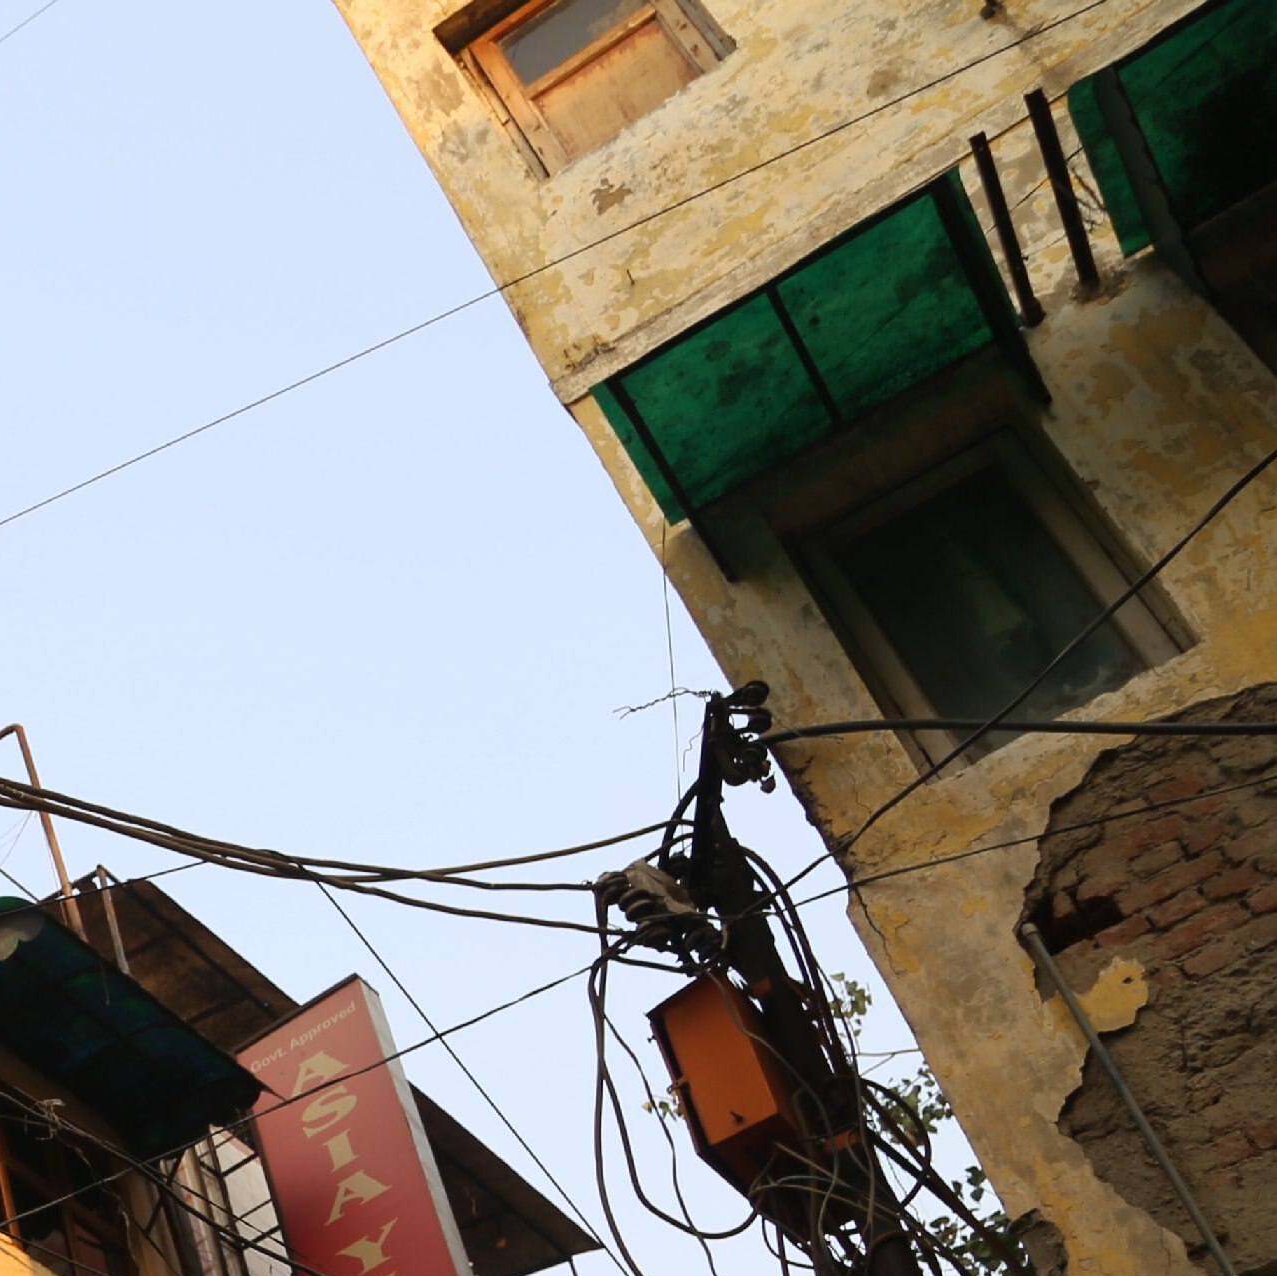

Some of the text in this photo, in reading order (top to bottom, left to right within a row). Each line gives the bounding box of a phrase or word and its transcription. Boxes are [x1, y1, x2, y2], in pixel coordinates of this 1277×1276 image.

[250, 1000, 357, 1074] Govt. Approved
[291, 1051, 393, 1226] ASIA
